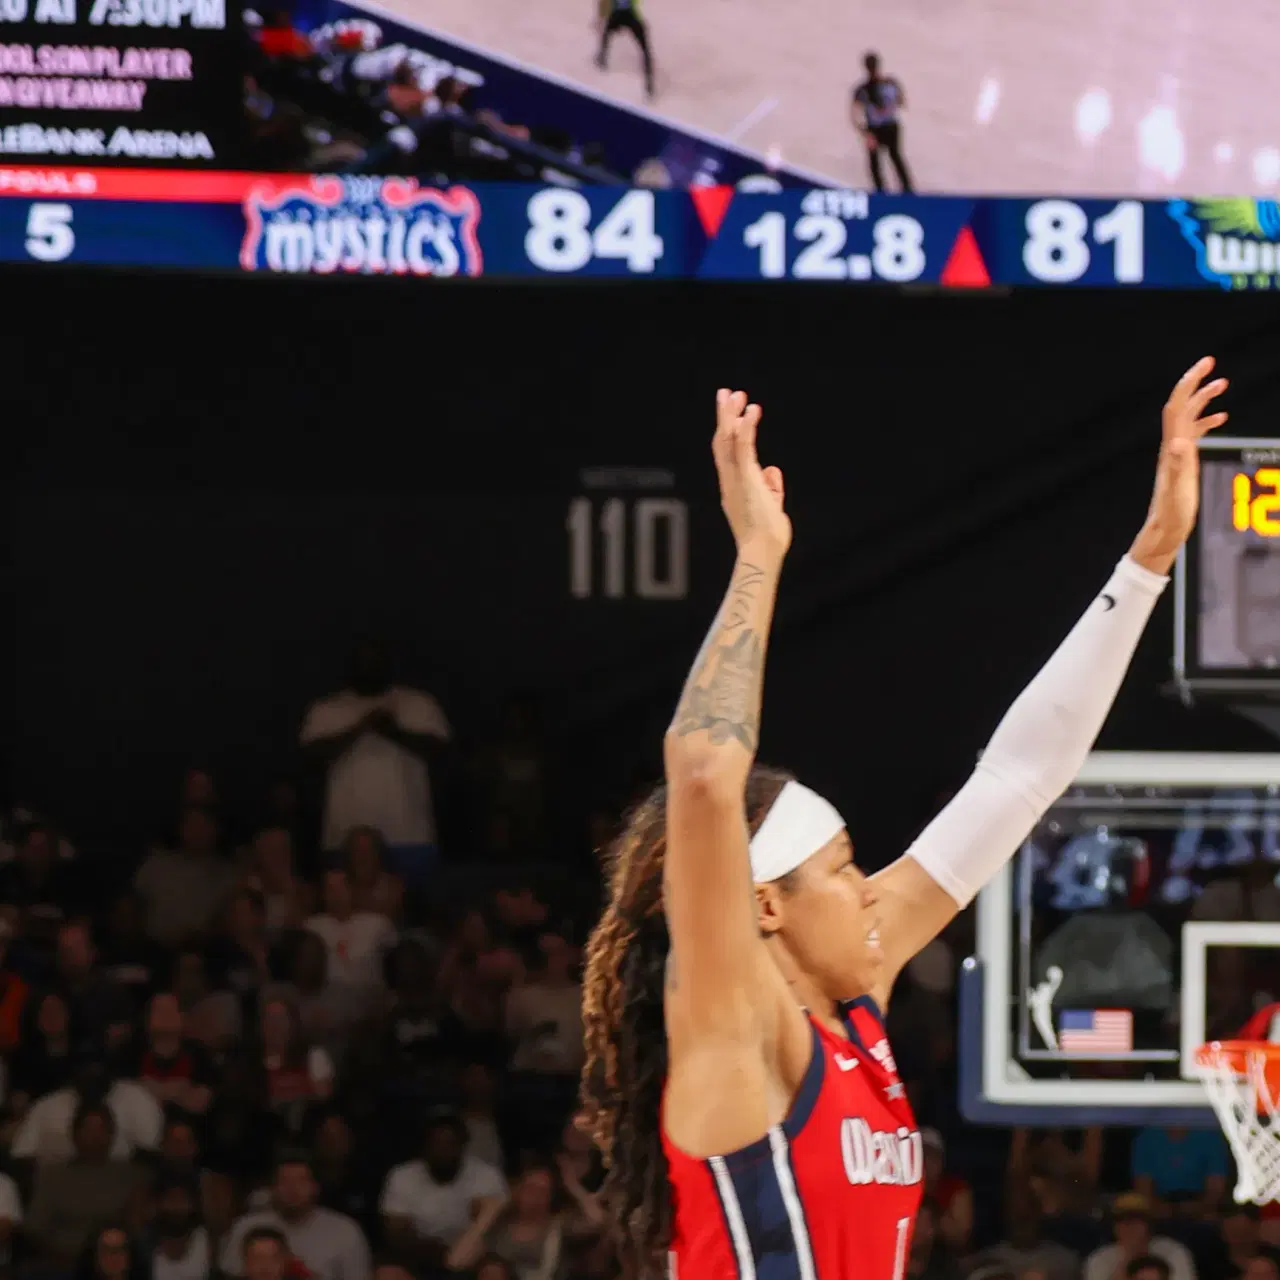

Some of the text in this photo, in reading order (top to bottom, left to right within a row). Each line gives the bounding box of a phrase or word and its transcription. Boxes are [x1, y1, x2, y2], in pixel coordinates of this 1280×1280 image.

[25, 204, 75, 261] 5
[524, 188, 663, 274] 84
[743, 210, 925, 282] 12.8
[1022, 199, 1144, 284] 81
[566, 496, 689, 600] 110
